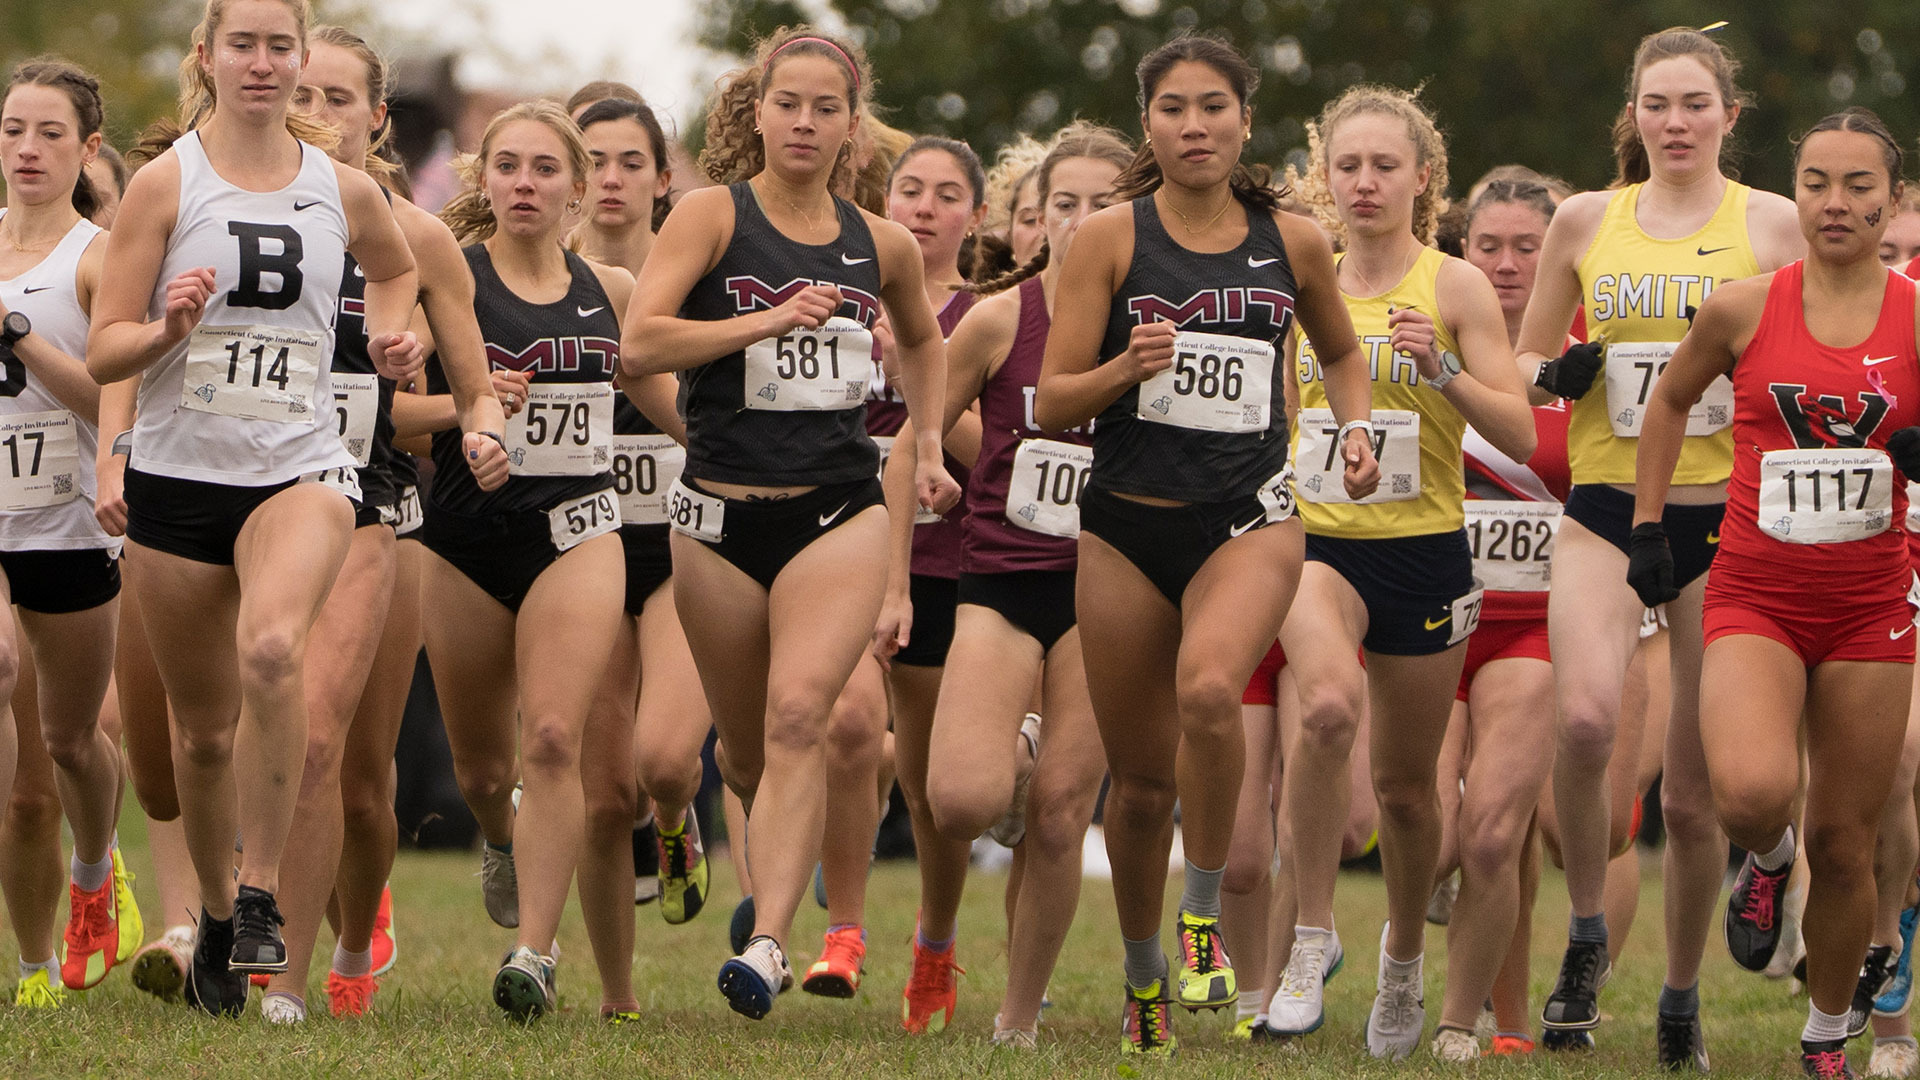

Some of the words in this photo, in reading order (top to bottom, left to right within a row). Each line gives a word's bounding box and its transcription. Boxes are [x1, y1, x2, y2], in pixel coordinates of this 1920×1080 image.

[227, 220, 304, 311] B
[725, 275, 879, 327] MT
[1128, 287, 1295, 328] MIT
[225, 340, 290, 391] 114
[485, 336, 619, 374] MIT
[775, 335, 840, 380] 581
[1200, 343, 1227, 353] College
[1227, 346, 1269, 357] Invitational
[1299, 336, 1419, 387] STH
[550, 392, 576, 402] College
[576, 390, 611, 400] Invitational
[1174, 352, 1245, 402] 586
[0, 423, 23, 433] ollege
[24, 418, 69, 430] Invitational
[526, 402, 590, 445] 579
[1371, 418, 1413, 427] nvitational
[2, 431, 45, 478] 17
[614, 444, 636, 453] ollege
[636, 442, 678, 452] Invitational
[1813, 457, 1840, 468] College
[613, 453, 657, 495] 80
[1783, 468, 1873, 512] 1117
[565, 494, 615, 535] 579
[670, 490, 704, 531] 581
[1469, 519, 1552, 562] 1262
[1464, 598, 1482, 631] 72
